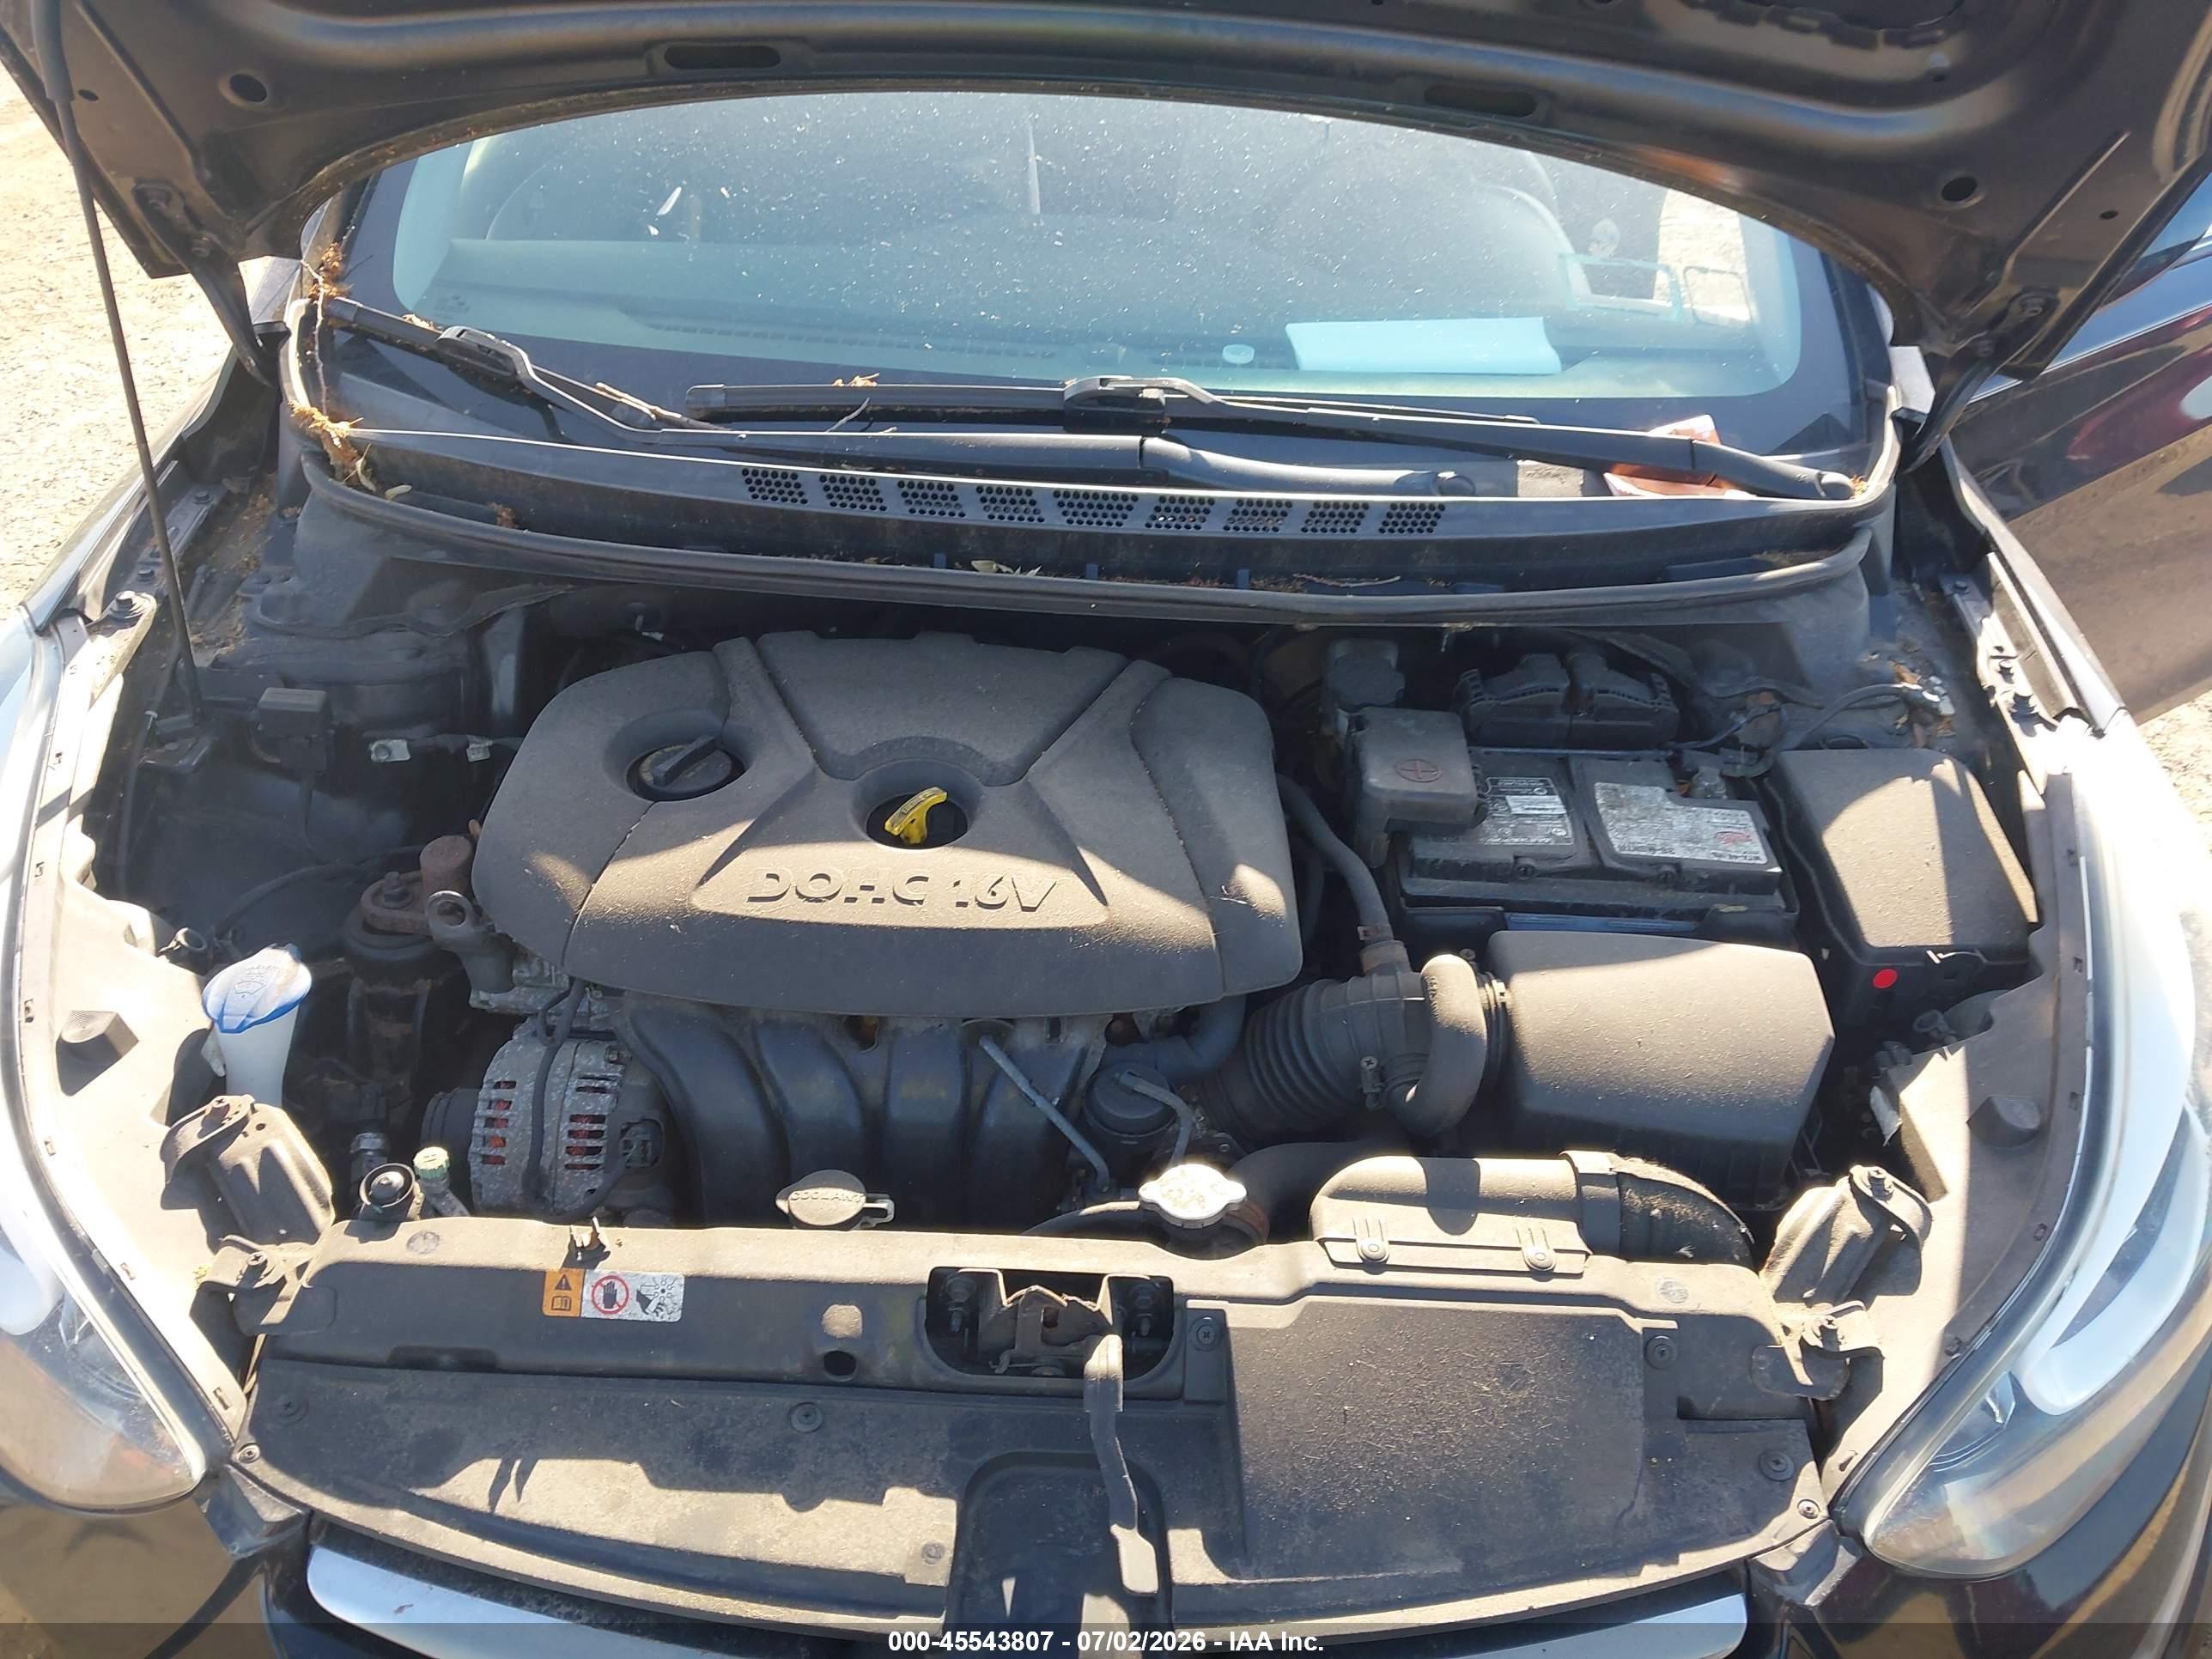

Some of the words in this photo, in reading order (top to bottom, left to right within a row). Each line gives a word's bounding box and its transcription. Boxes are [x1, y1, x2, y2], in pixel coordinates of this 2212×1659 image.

[746, 866, 931, 904] DOHC
[951, 872, 1058, 913] 16V
[790, 1190, 866, 1203] COOLANT
